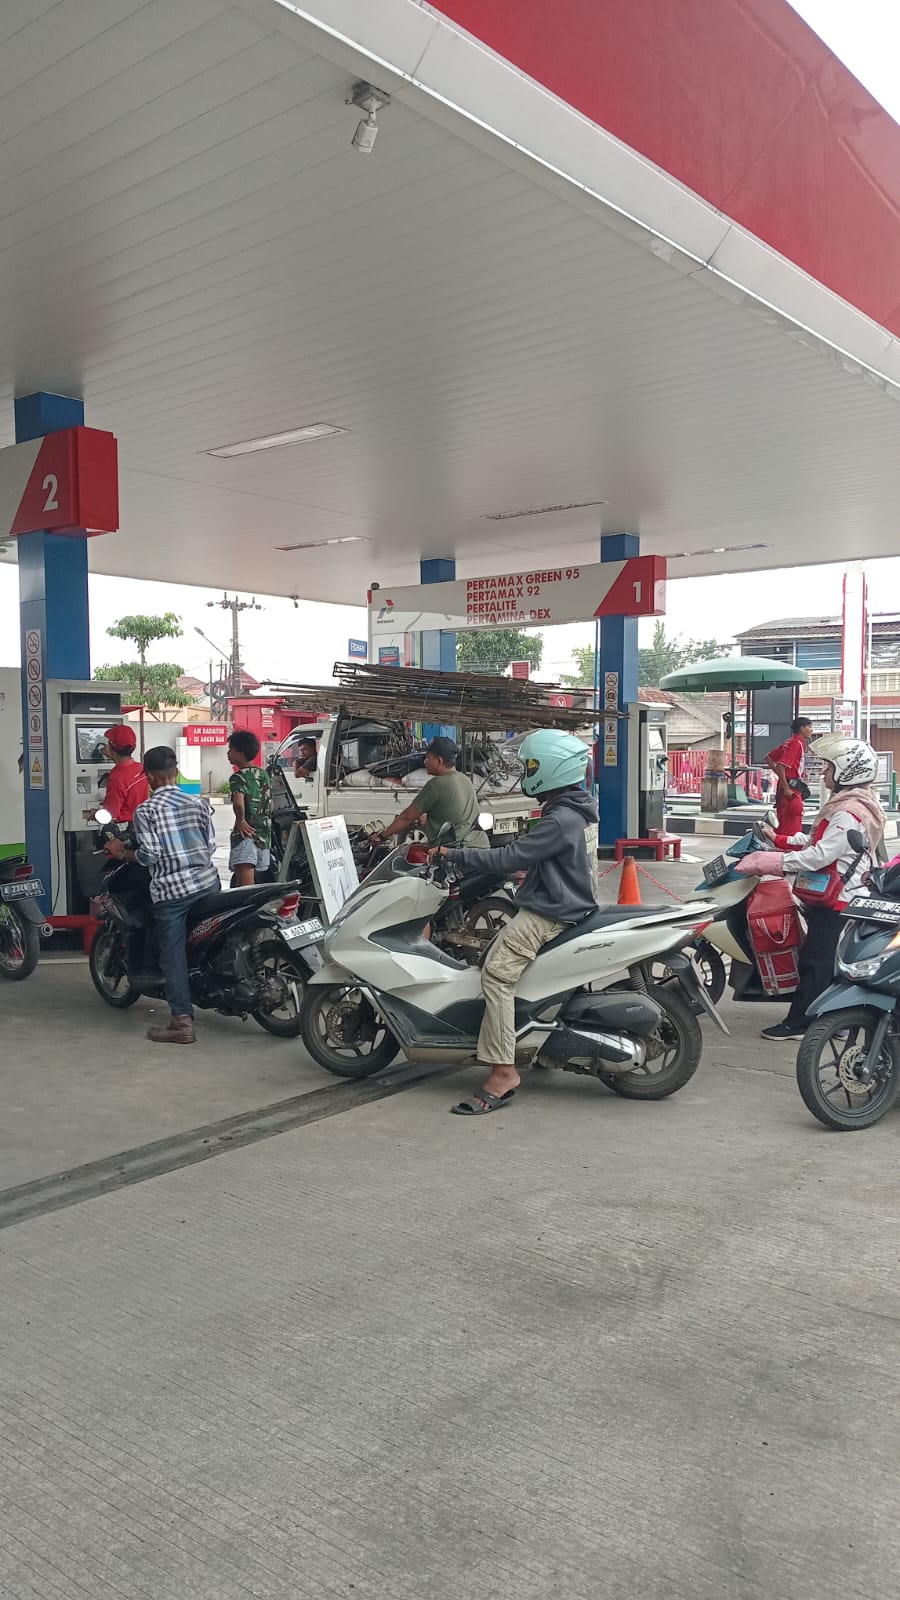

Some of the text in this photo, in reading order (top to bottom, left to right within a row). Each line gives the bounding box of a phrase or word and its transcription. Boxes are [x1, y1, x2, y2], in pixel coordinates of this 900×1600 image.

[42, 473, 58, 512] 2
[467, 568, 580, 591] PERTAMAX GREEN 95
[467, 585, 540, 603] PERTAMAX 92
[632, 580, 642, 603] 1
[467, 599, 517, 614] PERTALITE
[467, 608, 551, 625] PERTAMINA DEX
